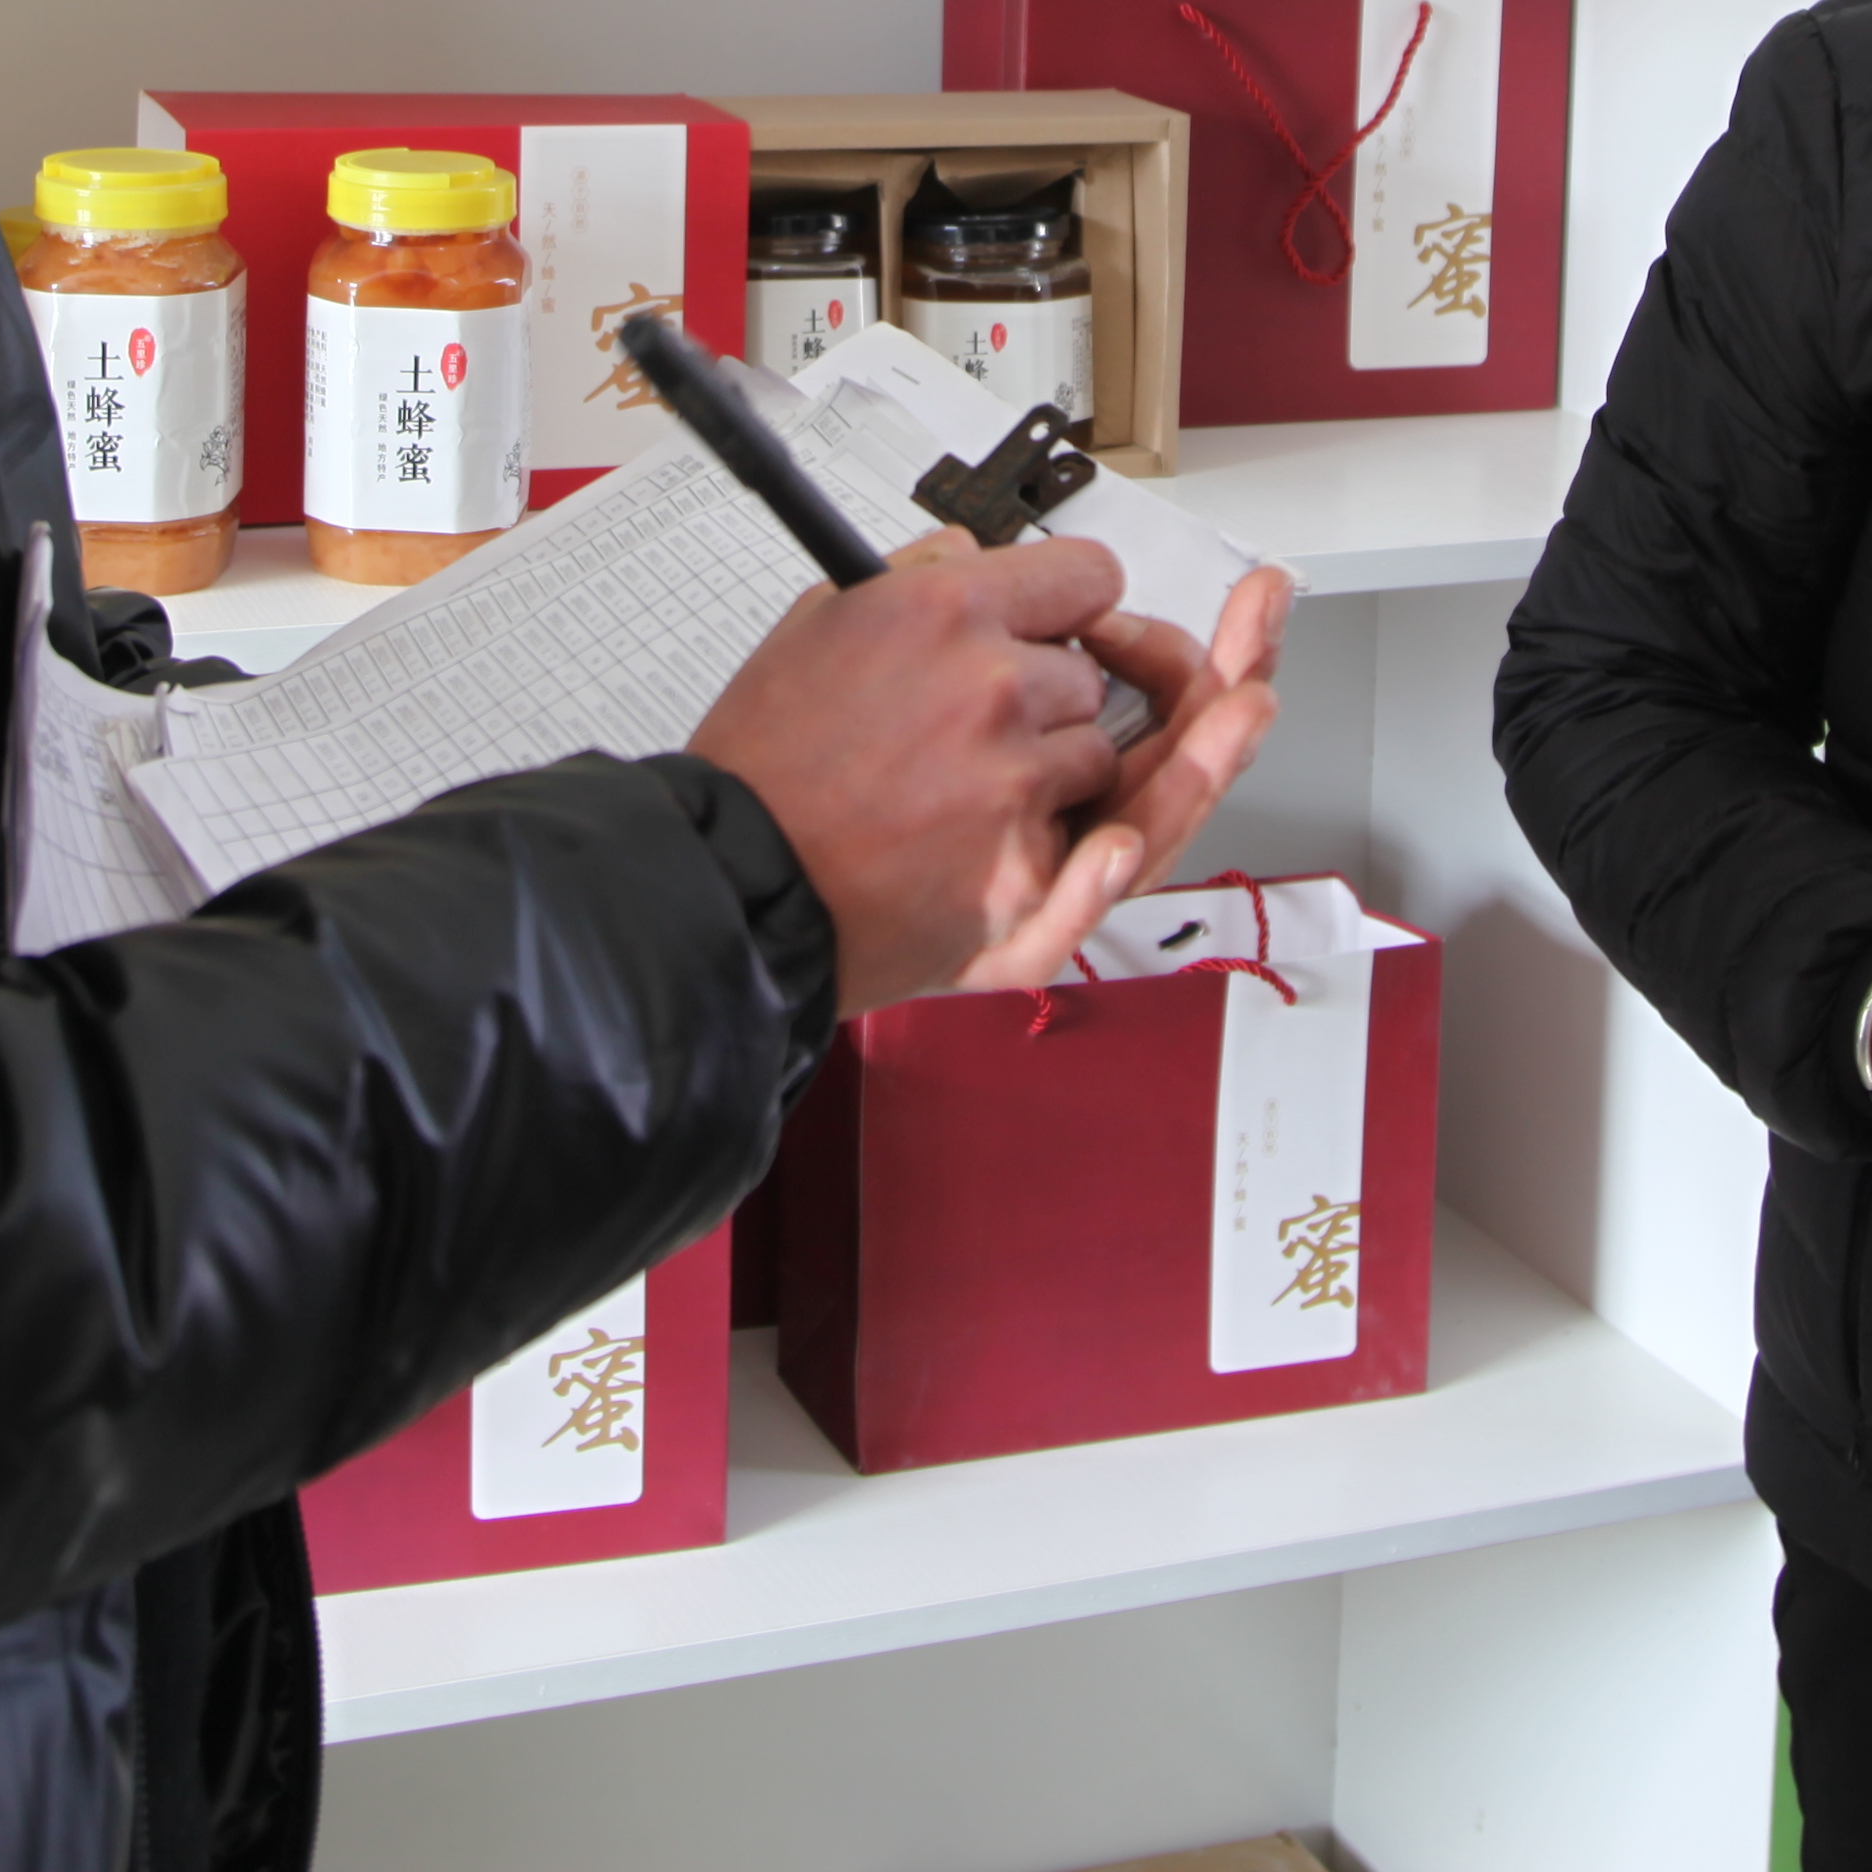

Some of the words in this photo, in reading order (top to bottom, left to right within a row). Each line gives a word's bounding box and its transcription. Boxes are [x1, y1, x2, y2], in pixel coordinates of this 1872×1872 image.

[1407, 203, 1492, 319] 蜜
[84, 341, 126, 473] 土蜂蜜
[376, 442, 387, 483] 地方特产
[377, 392, 388, 433] 绿色天然
[396, 355, 437, 485] 土蜂蜜
[1271, 1195, 1360, 1311] 蜜
[542, 1328, 644, 1453] 蜜
